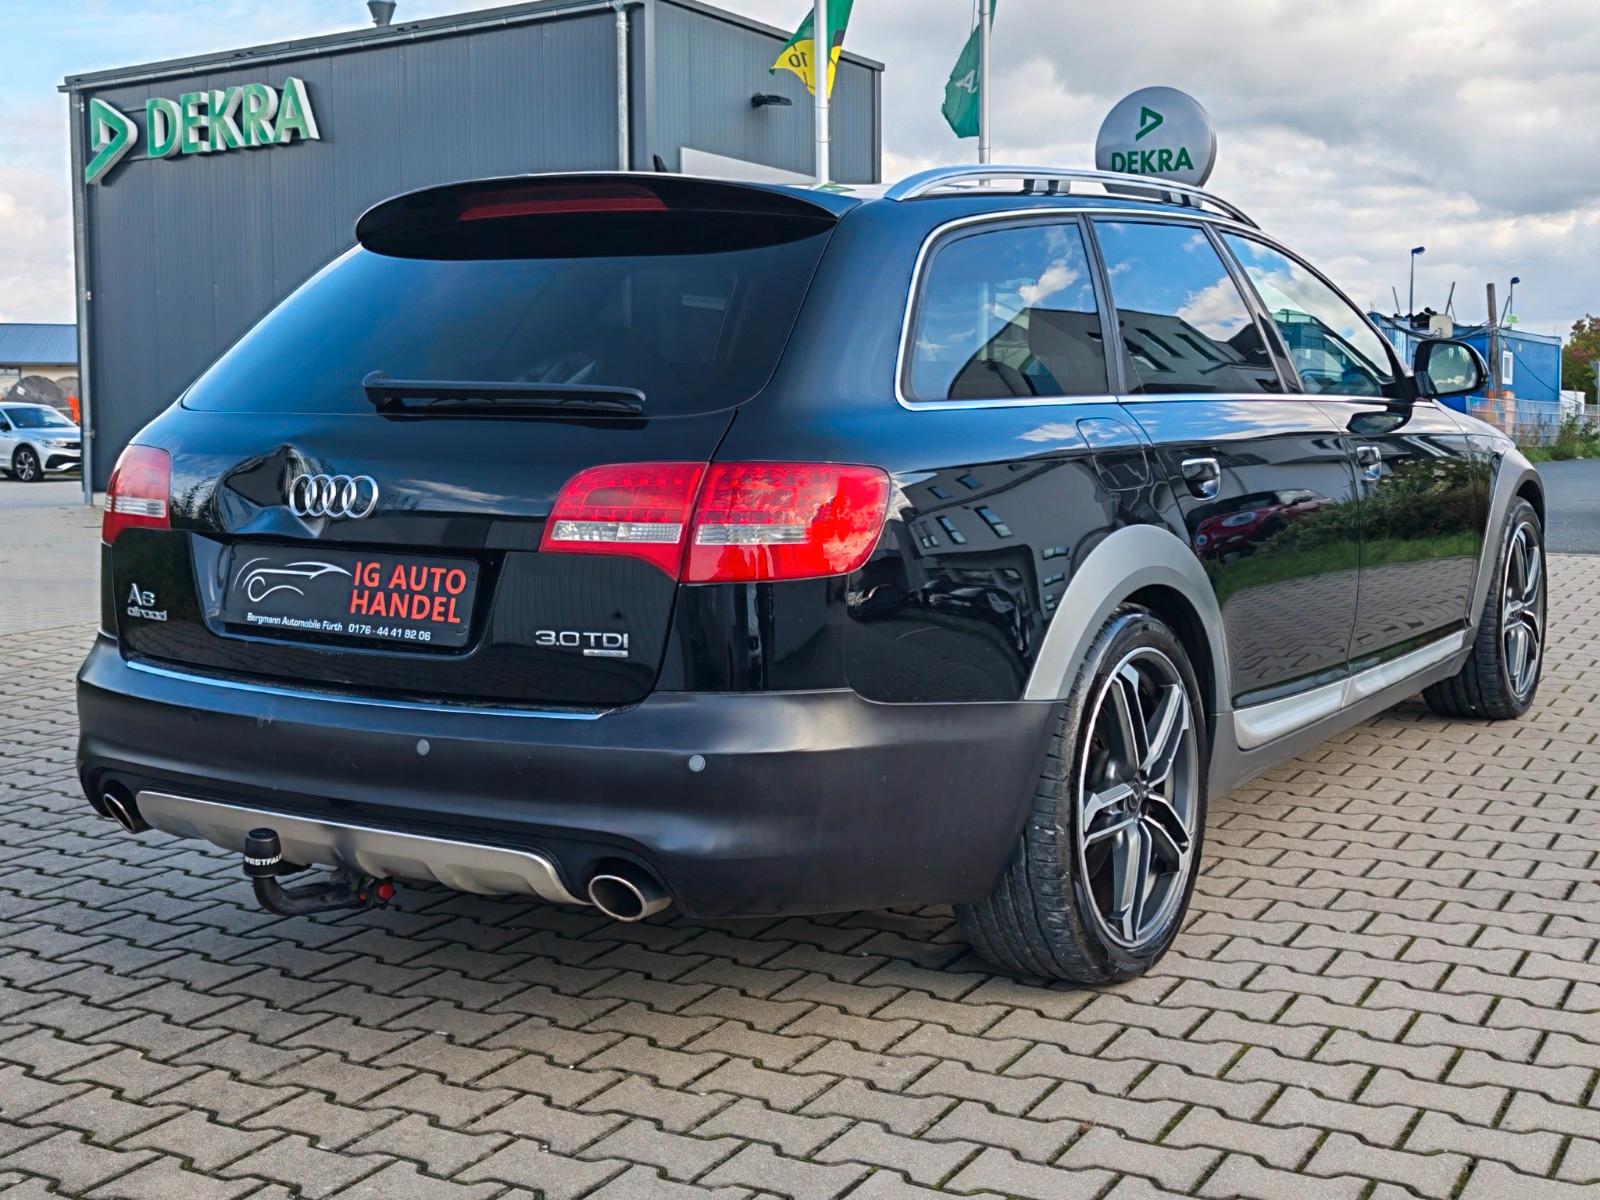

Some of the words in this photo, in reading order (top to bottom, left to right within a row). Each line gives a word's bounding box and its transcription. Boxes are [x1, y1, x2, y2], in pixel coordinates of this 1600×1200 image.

[145, 76, 320, 158] DEKRA
[1111, 146, 1194, 174] DEKRA
[354, 561, 381, 588] IG
[388, 564, 466, 595] AUTO
[127, 583, 155, 606] A6
[349, 589, 461, 624] HANDEL
[246, 612, 281, 625] Bergmann
[281, 616, 321, 630] Automobile
[348, 623, 372, 635] 0176
[376, 626, 389, 637] 44
[390, 628, 402, 638] 41
[418, 630, 432, 641] 06
[535, 630, 580, 647] 3.0
[582, 632, 629, 649] TDI
